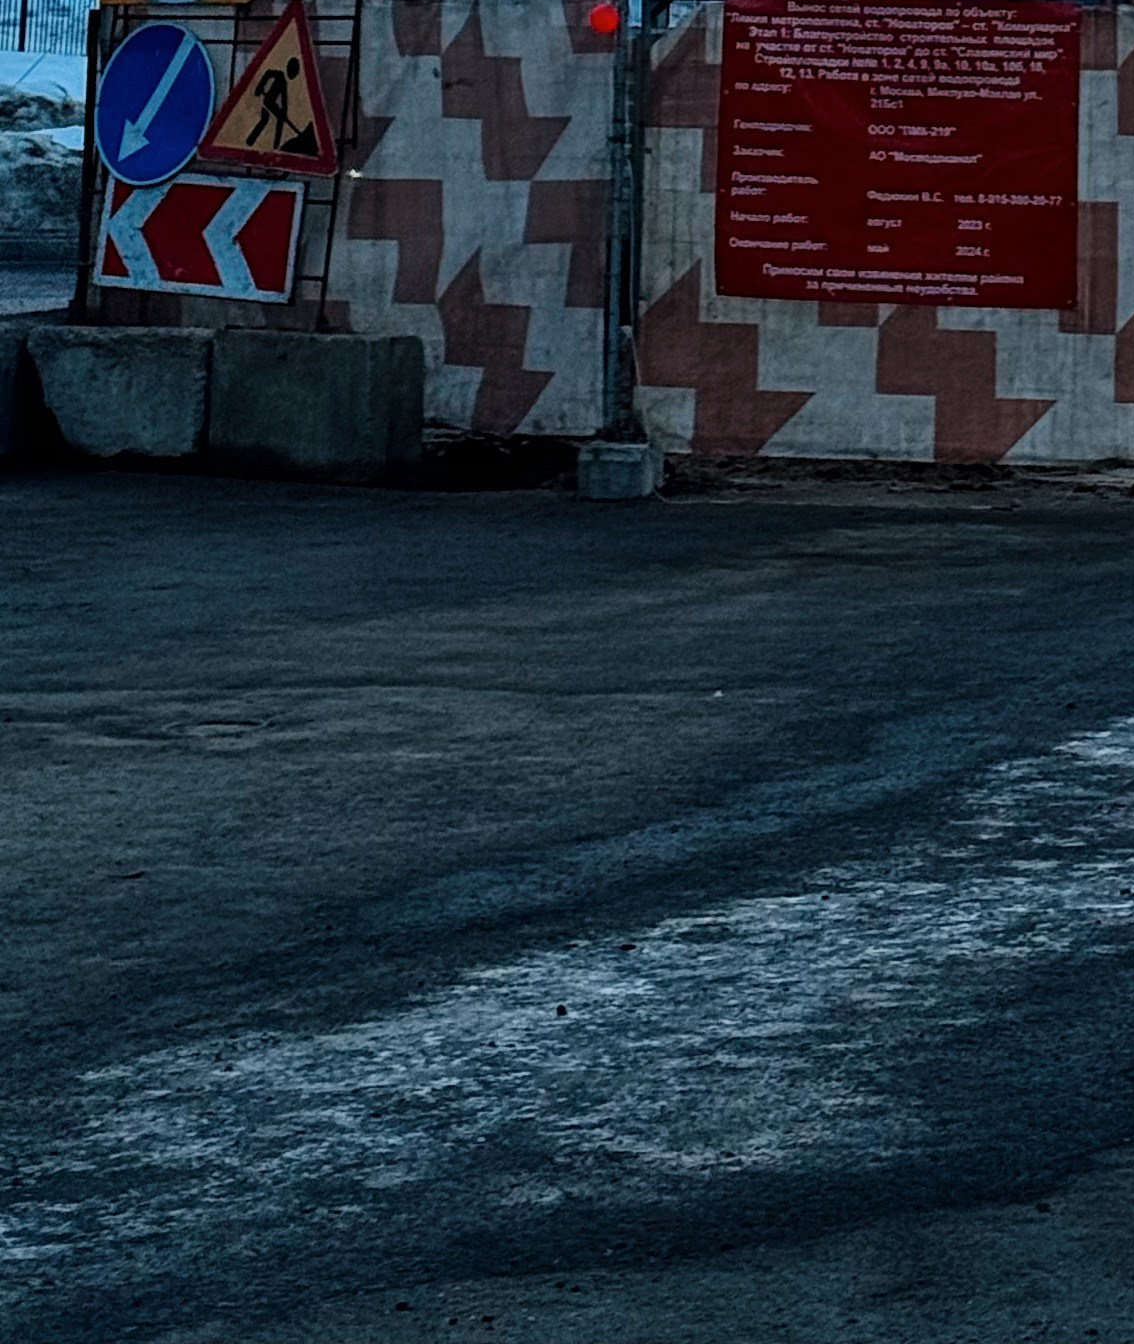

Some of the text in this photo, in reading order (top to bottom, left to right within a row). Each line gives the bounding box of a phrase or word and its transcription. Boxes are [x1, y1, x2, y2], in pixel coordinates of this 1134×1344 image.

[787, 1, 1017, 20] Вынос сетей водопровода по объекту:
[726, 13, 768, 24] "Линия
[771, 16, 862, 28] метрополитена,
[972, 23, 988, 31] ст.
[748, 26, 778, 38] Этап
[793, 28, 894, 42] Благоустройство
[899, 33, 987, 46] строительных
[993, 36, 1054, 46] площадок
[736, 42, 750, 50] на
[803, 44, 816, 53] от
[914, 48, 930, 57] до
[894, 59, 905, 70] 2,
[906, 59, 917, 70] 4,
[780, 68, 796, 80] 12,
[861, 73, 869, 81] в
[872, 73, 899, 82] зоне
[902, 72, 936, 83] сетей
[734, 82, 749, 90] по
[751, 83, 792, 94] адресу:
[880, 86, 924, 97] Москва,
[867, 124, 896, 135] ООО
[869, 150, 887, 161] АО
[730, 211, 770, 222] Начало
[867, 218, 902, 228] август
[729, 237, 789, 249] Окончание
[955, 246, 982, 256] 2024
[763, 263, 824, 277] Приносим
[826, 269, 856, 277] свои
[858, 270, 922, 280] извинения
[925, 272, 978, 282] жителям
[806, 280, 819, 289] за
